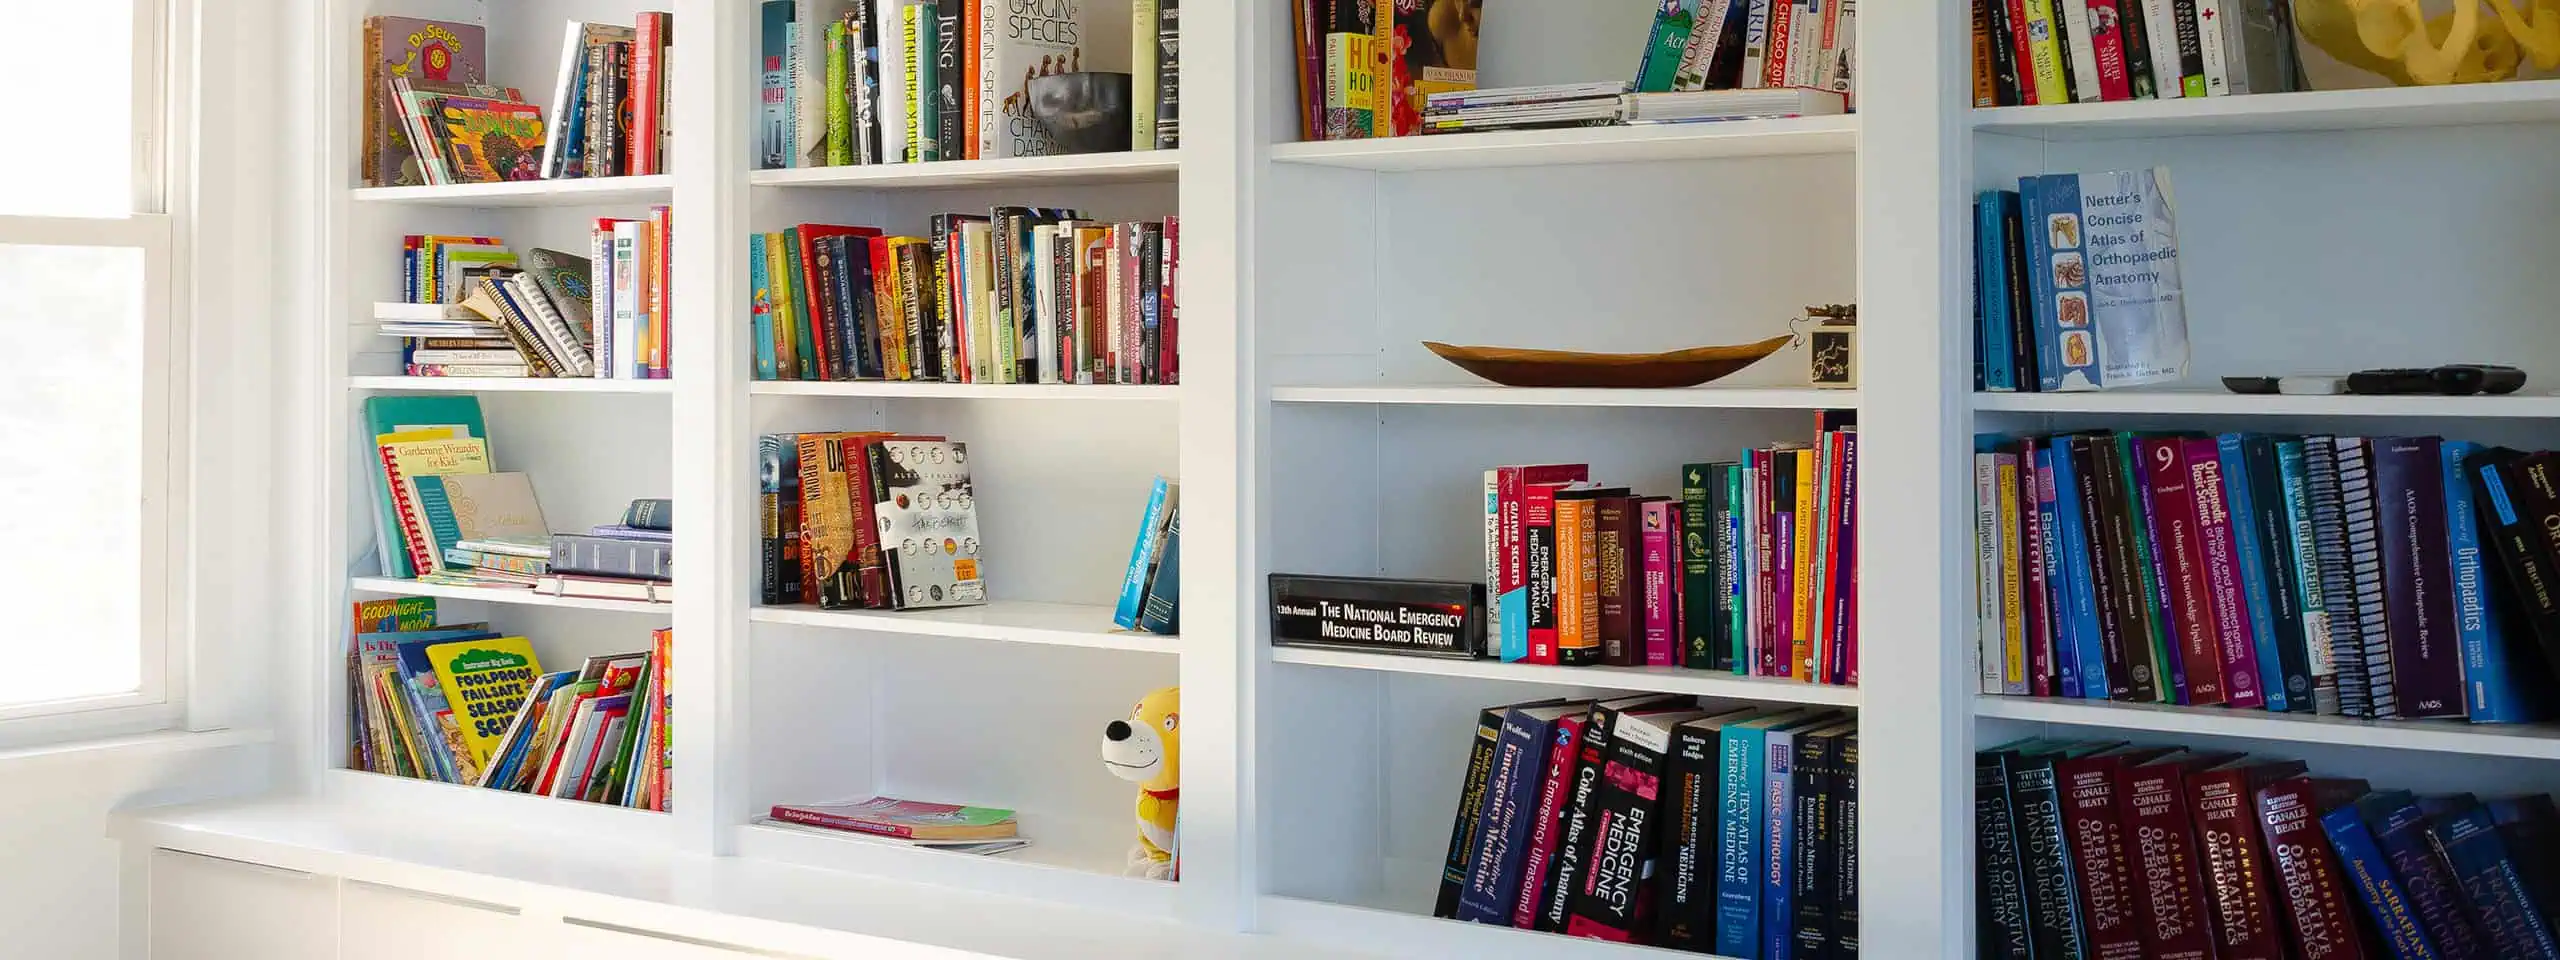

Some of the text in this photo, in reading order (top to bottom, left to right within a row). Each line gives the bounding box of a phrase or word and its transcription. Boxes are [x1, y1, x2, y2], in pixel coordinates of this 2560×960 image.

[408, 24, 463, 54] Dr. Seuss
[938, 15, 957, 69] JUNG
[1008, 15, 1078, 45] SPECIES
[1700, 15, 1722, 72] FRANCISCO
[1775, 3, 1790, 60] CHICAGO
[983, 4, 995, 132] ORIGIN SPECIES
[1328, 38, 1337, 102] PAUL THEROUX
[2036, 48, 2046, 79] SHEM
[2043, 46, 2053, 81] SAMUEL
[2102, 46, 2113, 79] SHEM
[2109, 39, 2121, 82] SAMUEL
[2085, 193, 2141, 208] Netter's
[2088, 212, 2142, 227] Concise
[2090, 230, 2144, 247] Atlas of
[2092, 248, 2177, 267] Orthopaedic
[901, 259, 918, 338] ROBERT LUDLUM
[936, 277, 944, 321] VANITIES
[1001, 289, 1009, 306] WAR
[1064, 240, 1073, 331] WAR PEACE WAR
[2095, 270, 2160, 286] Anatomy
[1145, 293, 1157, 324] Salt
[399, 442, 481, 457] Gardening Wizardry
[427, 456, 458, 468] for Kids
[801, 441, 814, 462] DAN
[893, 472, 920, 480] ALEX
[2156, 446, 2174, 472] 9
[803, 463, 821, 502] BROWN
[847, 446, 863, 522] THE DA VINCI CODE
[1843, 441, 1854, 525] PALS Provider Manual
[856, 528, 865, 545] DAN
[1511, 501, 1519, 585] GI/LIVER SECRETS
[1608, 531, 1618, 597] DIAGNOSTIC
[1718, 510, 1727, 611] SPLINTERS FRACTURES
[1982, 510, 1995, 561] Orthopaedics
[2041, 511, 2057, 577] Backache
[2191, 463, 2237, 664] Basic Science Musculoskeletal System
[2203, 460, 2245, 660] Orthopaedic Biology and Biomechanics
[2293, 477, 2321, 608] REVIEW ORTHOPAEDICS
[1530, 529, 1541, 627] MEDICINE MANUAL
[1540, 546, 1550, 608] EMERGENCY
[2172, 519, 2203, 655] Orthopaedic Knowledge Update
[2405, 488, 2430, 660] AAOS Comprehensive Orthopaedic Review
[2457, 547, 2481, 631] Orthopaedics
[363, 602, 424, 620] GOODNIGHT
[1277, 604, 1317, 617] 13th Annual
[1321, 620, 1453, 646] MEDICINE BOARD REVIEW
[1344, 603, 1397, 624] NATIONAL
[1399, 607, 1462, 628] EMERGENCY
[455, 668, 532, 688] FOOLPROOF
[461, 682, 523, 702] FAILSAFE
[2195, 684, 2216, 694] AAOS
[1506, 722, 1532, 740] Wolfson
[1725, 738, 1738, 882] EMERGENCY MEDICINE
[2017, 778, 2051, 789] EDITION
[2072, 786, 2111, 798] CANALE
[2078, 797, 2108, 809] BEATY
[2132, 794, 2172, 806] CANALE
[2139, 804, 2170, 816] BEATY
[2201, 798, 2237, 810] CANALE
[1473, 743, 1517, 893] Emergency Medicine
[1737, 790, 1749, 884] TEXT-ATLAS OF
[1770, 780, 1782, 887] BASIC PATHOLOGY
[2208, 808, 2236, 821] BEATY
[2267, 810, 2308, 825] CANALE
[2275, 820, 2307, 834] BEATY
[1518, 778, 1559, 914] Emergency Ultrasound
[1548, 766, 1597, 925] Color Atlas of Anatomy
[1596, 811, 1622, 900] MEDICINE
[1611, 807, 1645, 918] EMERGENCY
[1806, 797, 1815, 891] EMERGENCY MEDICINE
[1846, 801, 1856, 896] EMERGENCY MEDICINE
[1977, 799, 2006, 925] HAND SURGERY
[2023, 803, 2057, 929] HAND SURGERY
[2090, 819, 2120, 926] OPERATIVE
[2110, 823, 2132, 917] CAMPBELL'S
[1676, 845, 1689, 903] MEDICINE
[1992, 796, 2025, 957] GREEN'S OPERATIVE
[2040, 799, 2078, 960] GREEN'S OPERATIVE
[2077, 818, 2109, 931] ORTHOPAEDICS
[2138, 826, 2170, 940] ORTHOPAEDICS
[2150, 827, 2183, 936] OPERATIVE
[2206, 830, 2237, 946] ORTHOPAEDICS
[2219, 832, 2249, 941] OPERATIVE
[2238, 837, 2261, 934] CAMPBELL'S
[2276, 844, 2320, 960] ORTHOPAEDICS
[2291, 844, 2331, 954] OPERATIVE
[2353, 857, 2383, 907] Anatomy
